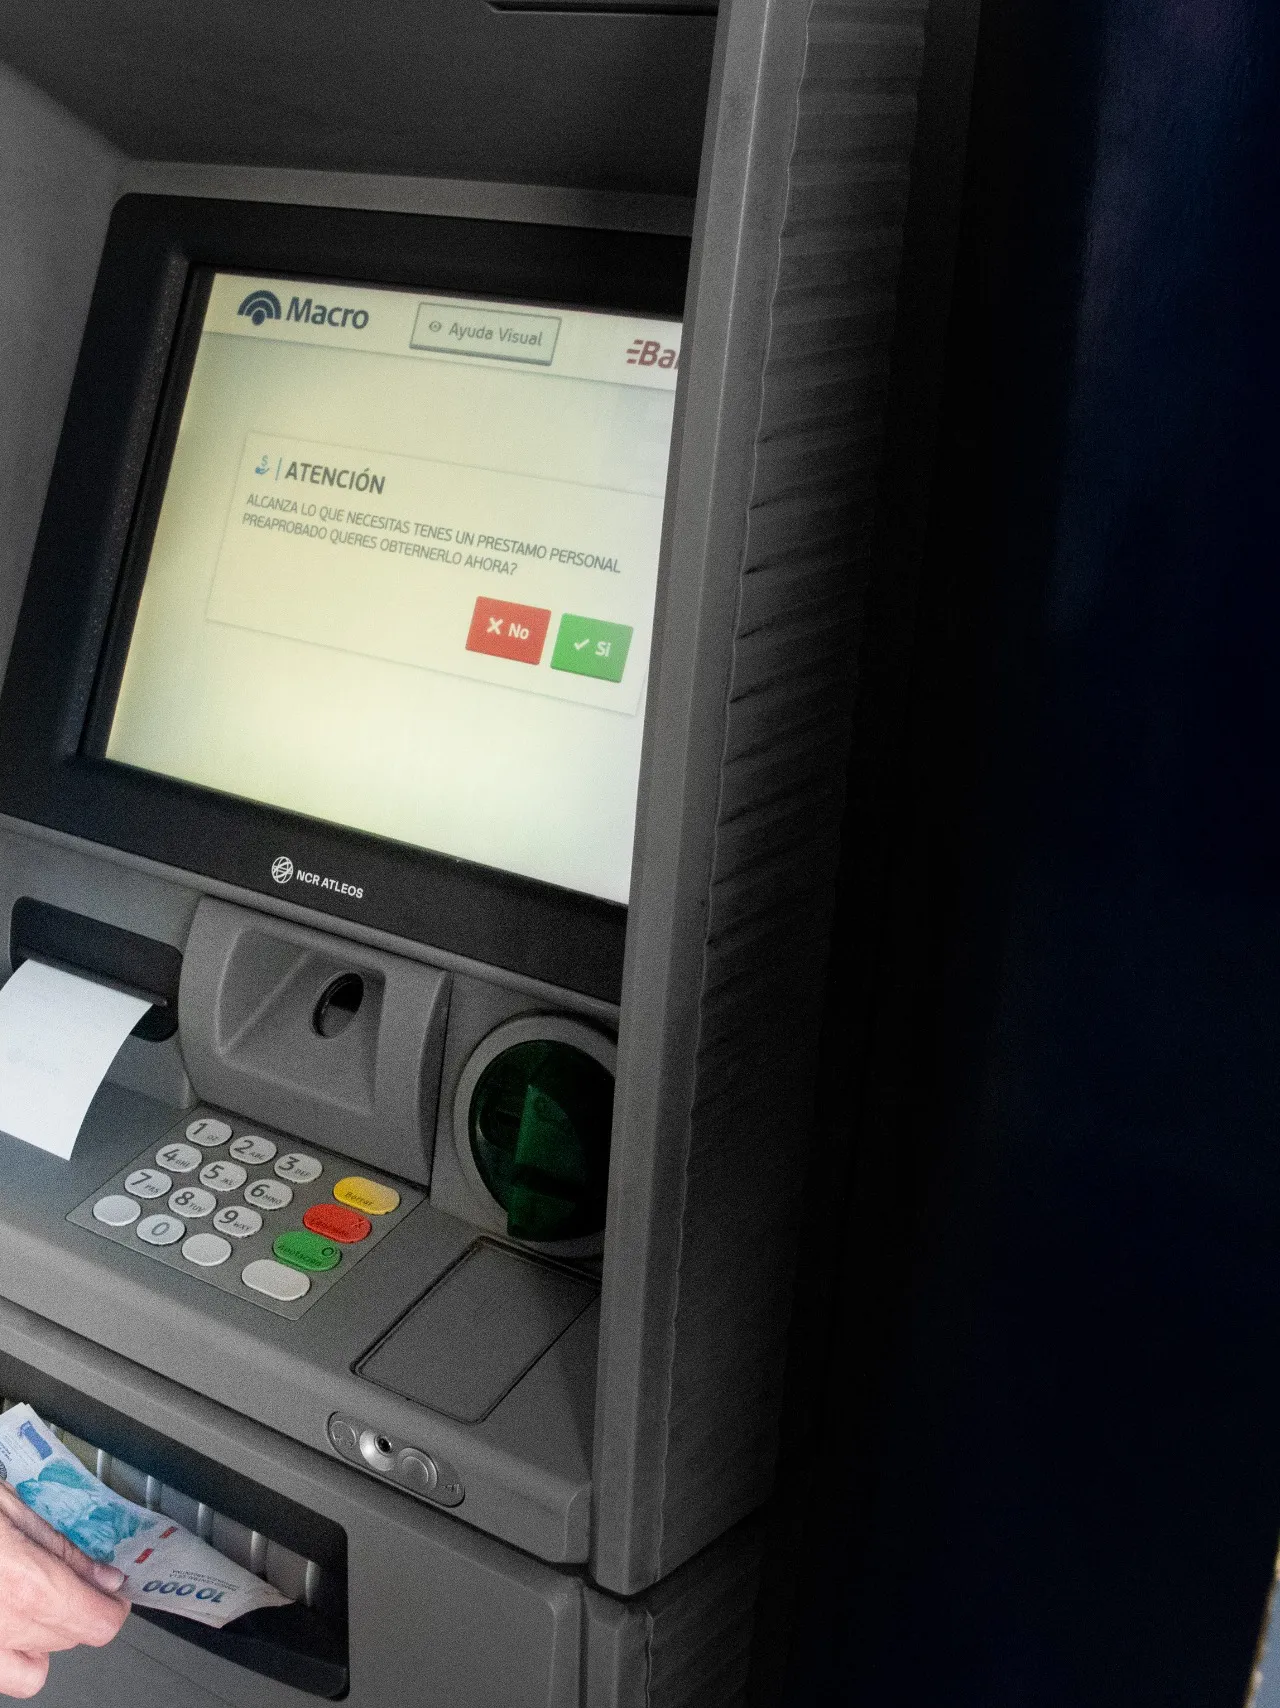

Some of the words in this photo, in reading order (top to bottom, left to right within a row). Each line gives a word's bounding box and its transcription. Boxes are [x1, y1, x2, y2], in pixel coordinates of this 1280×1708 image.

[286, 296, 370, 330] Macro
[448, 322, 492, 344] Ayuda
[498, 327, 543, 346] Visual
[284, 461, 385, 494] ATENCIÓN
[246, 494, 297, 514] ALCANZA
[300, 503, 317, 517] LO
[320, 506, 345, 522] QUE
[346, 511, 410, 534] NECESITAS
[414, 522, 452, 542] TENES
[456, 530, 474, 546] UN
[477, 534, 547, 559] PRESTAMO
[549, 548, 620, 573] PERSONAL
[242, 512, 328, 540] PREAPROBADO
[329, 529, 377, 549] QUERES
[380, 538, 462, 565] OBTERNERLO
[464, 554, 518, 576] AHORA?
[508, 623, 529, 640] No
[296, 870, 320, 886] NCR
[321, 878, 364, 898] ATLEOS
[193, 1123, 208, 1135] 1
[234, 1139, 254, 1154] 2
[163, 1148, 179, 1161] 4
[278, 1156, 300, 1170] 3
[131, 1172, 152, 1186] 7
[203, 1164, 224, 1179] 5
[175, 1191, 194, 1206] 8
[251, 1184, 270, 1198] 6
[219, 1210, 238, 1224] 9
[151, 1222, 170, 1236] 0
